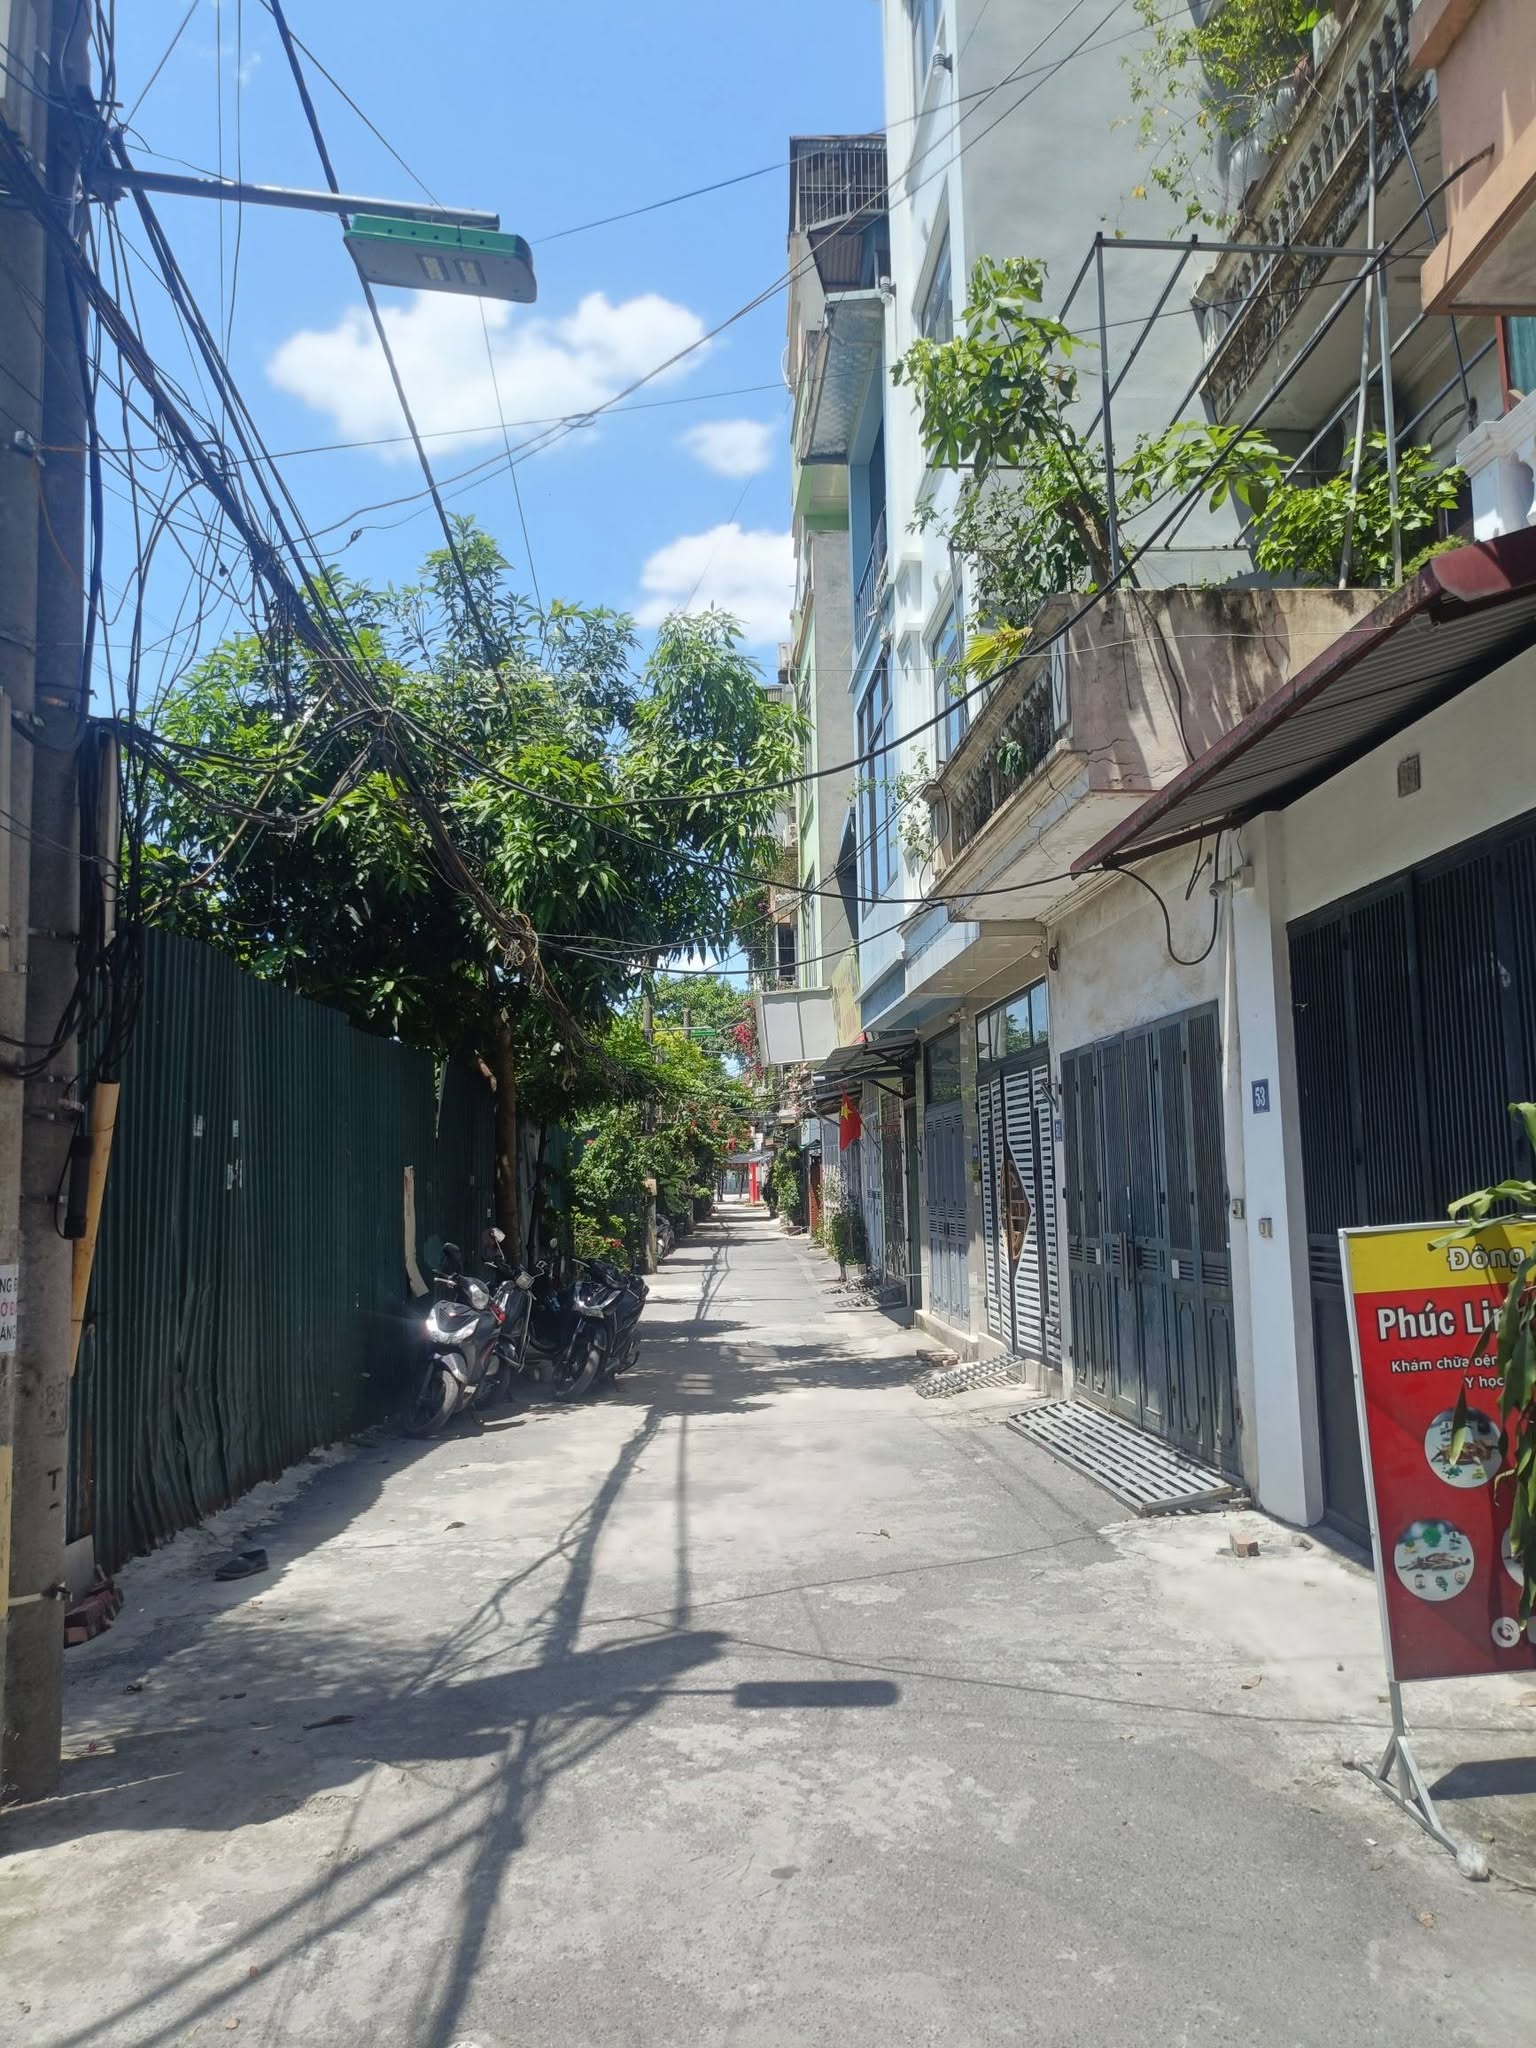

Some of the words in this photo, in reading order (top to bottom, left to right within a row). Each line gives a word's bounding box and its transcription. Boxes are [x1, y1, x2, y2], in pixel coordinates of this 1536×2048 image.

[1255, 1086, 1266, 1107] 53
[1447, 1244, 1526, 1273] Đông
[1377, 1301, 1455, 1341] Phúc
[1391, 1358, 1432, 1373] Khám
[1436, 1355, 1469, 1369] chữa
[1464, 1375, 1474, 1389] Y
[1479, 1375, 1504, 1390] học
